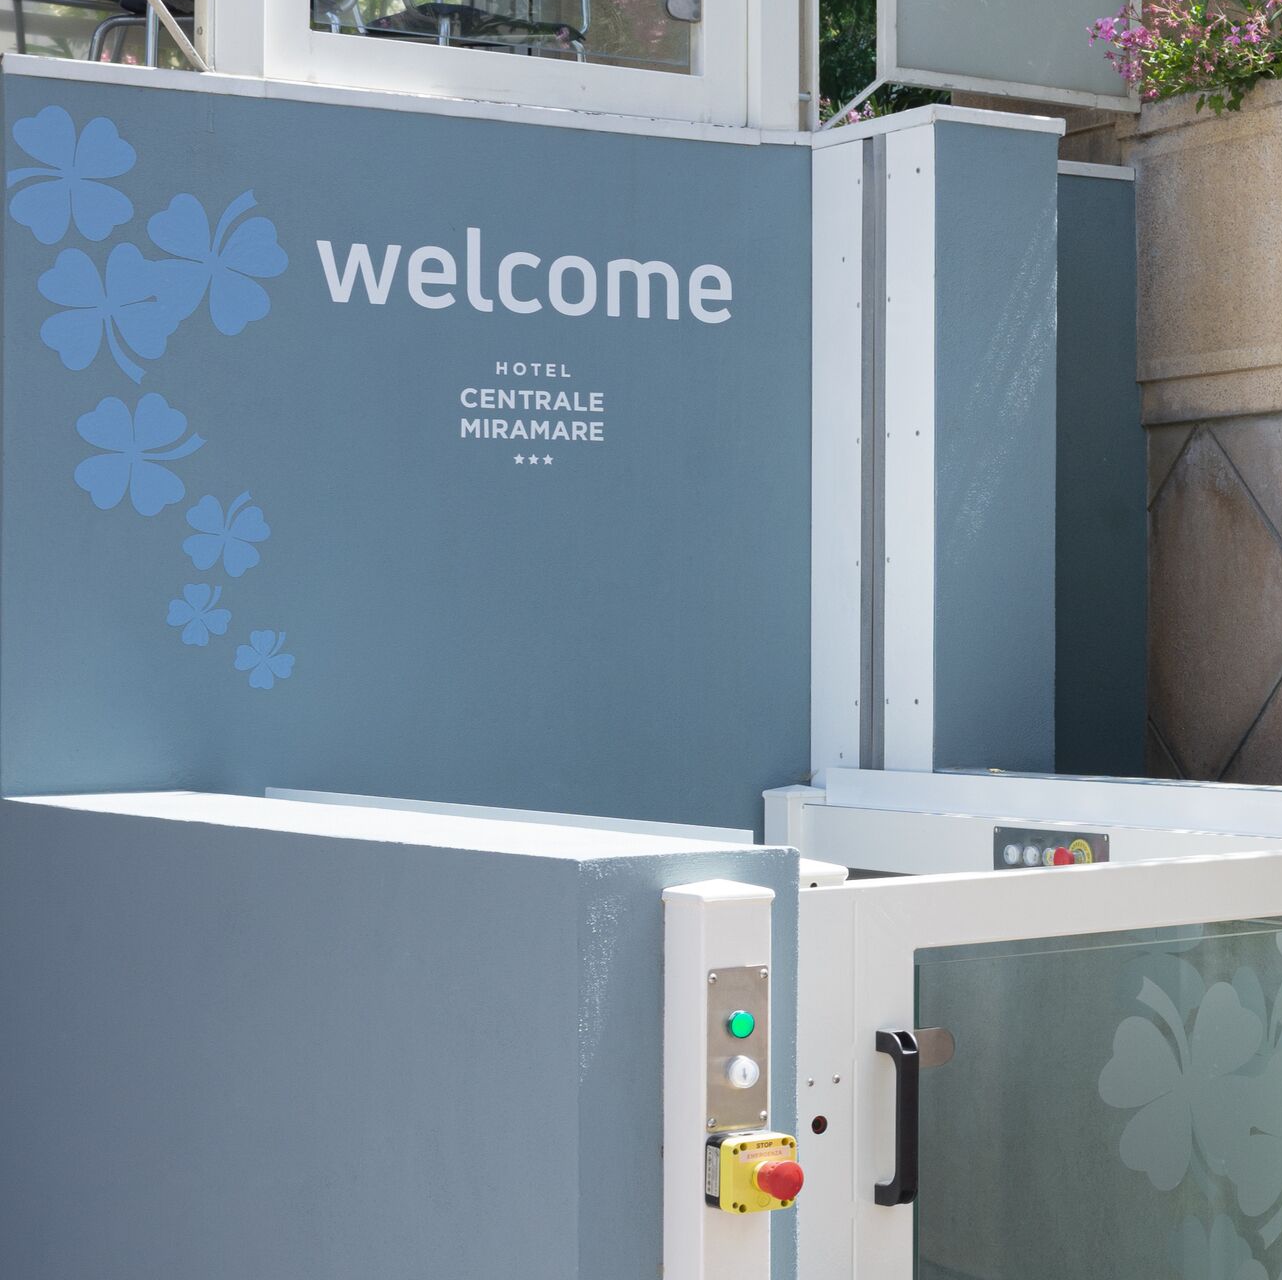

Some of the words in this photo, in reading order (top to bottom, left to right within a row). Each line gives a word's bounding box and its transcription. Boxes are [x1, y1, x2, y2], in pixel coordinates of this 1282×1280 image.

[316, 227, 733, 324] welcome
[495, 361, 572, 378] HOTEL
[460, 387, 605, 413] CENTRALE
[460, 418, 605, 442] MIRAMARE
[756, 1141, 773, 1149] STOP
